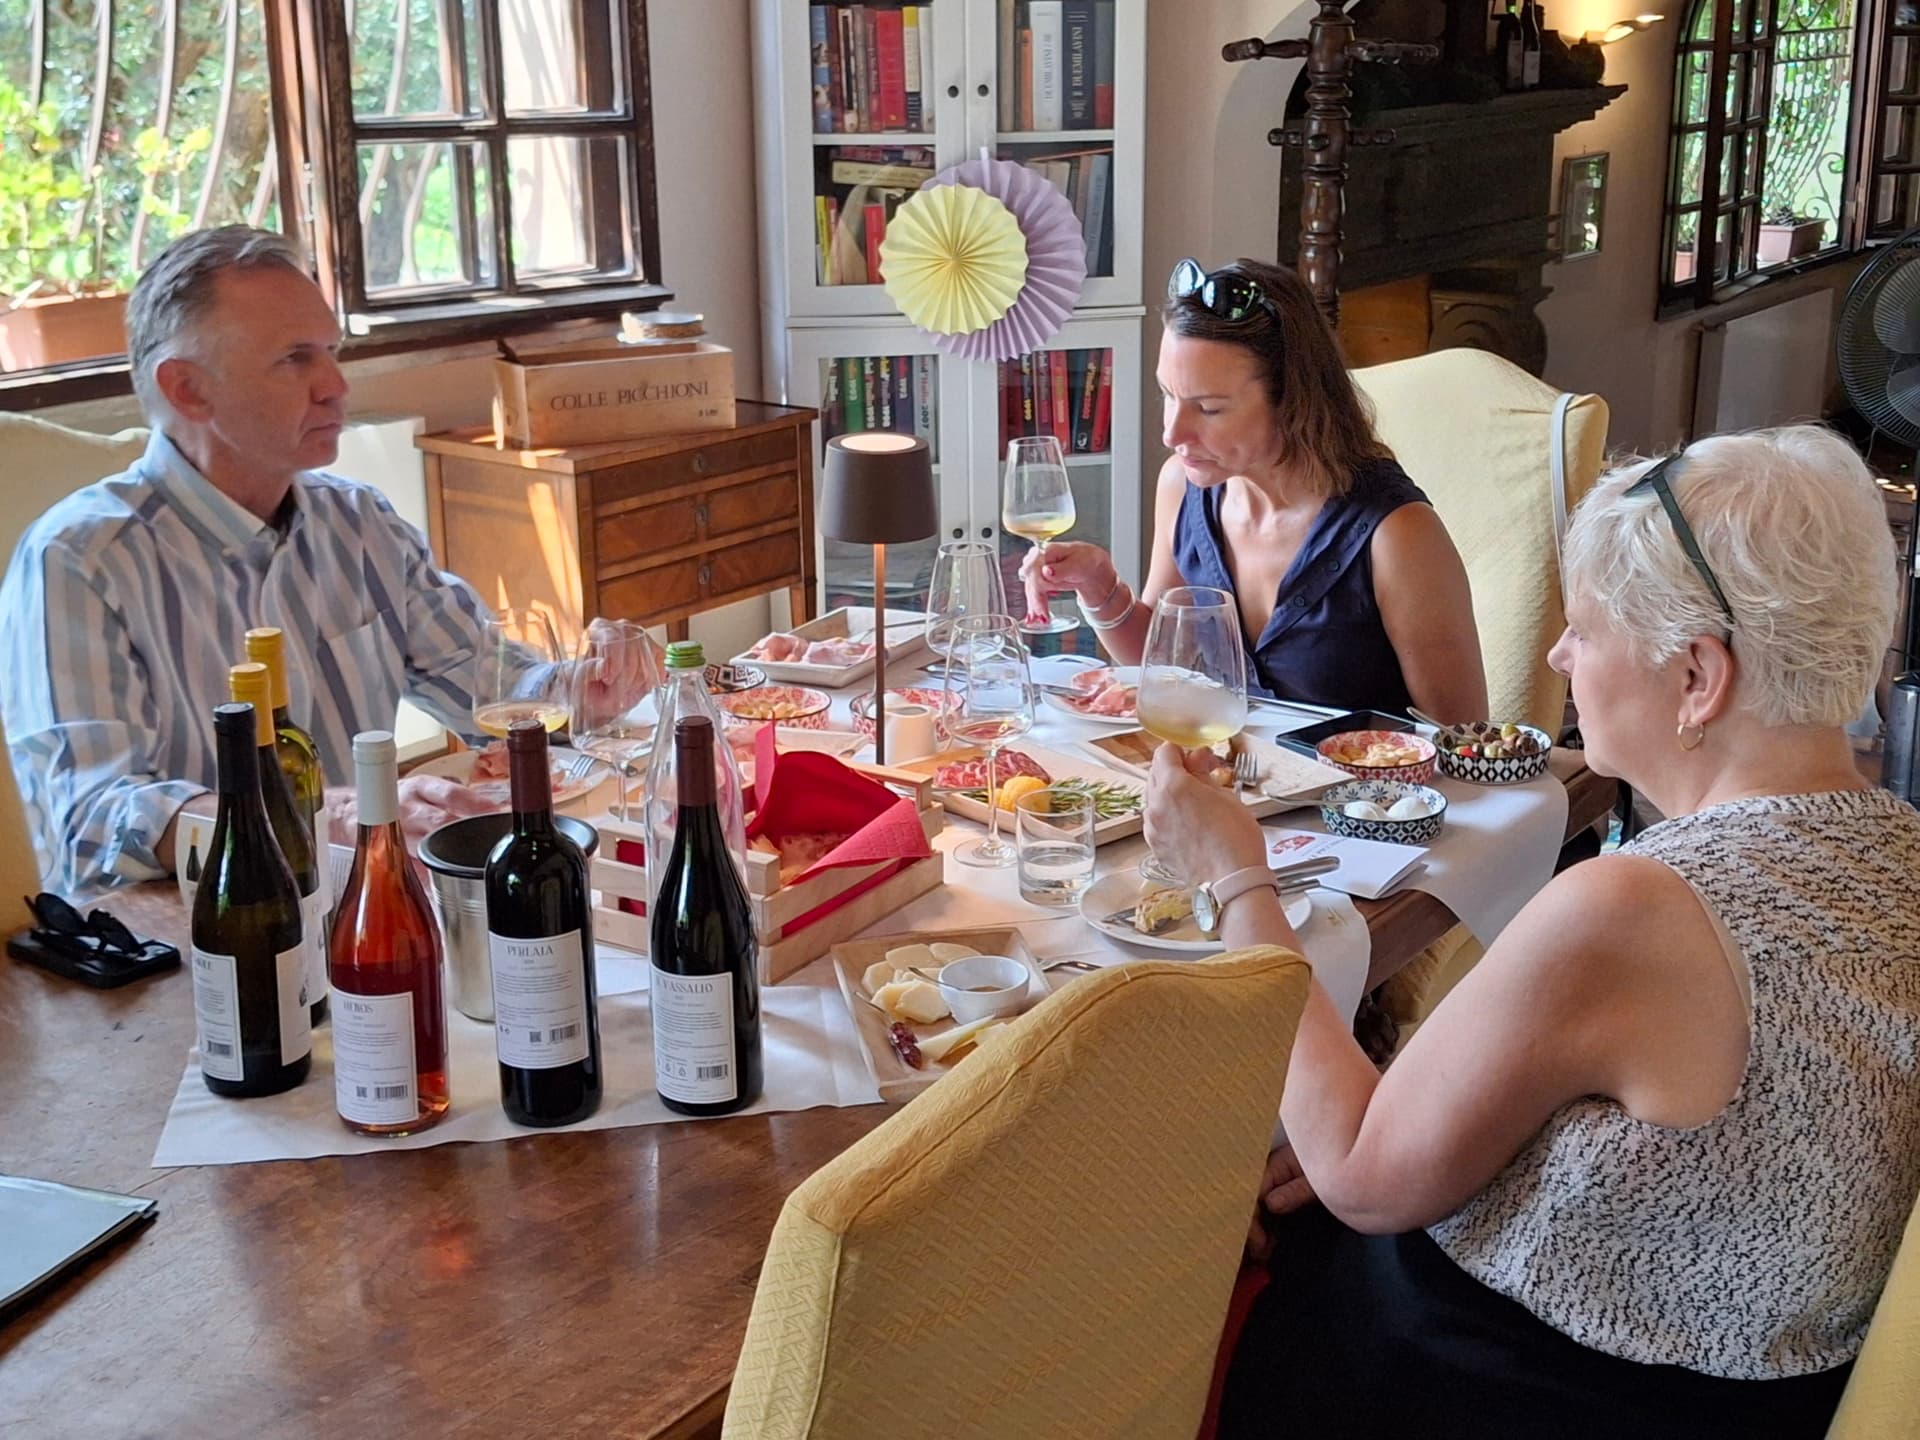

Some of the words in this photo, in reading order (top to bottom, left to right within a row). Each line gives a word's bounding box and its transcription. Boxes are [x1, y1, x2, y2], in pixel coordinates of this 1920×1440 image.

[1071, 26, 1083, 87] DUEMILAVINI
[550, 391, 608, 411] COLLE
[618, 380, 709, 405] PICCHIONI
[921, 405, 929, 429] 2007
